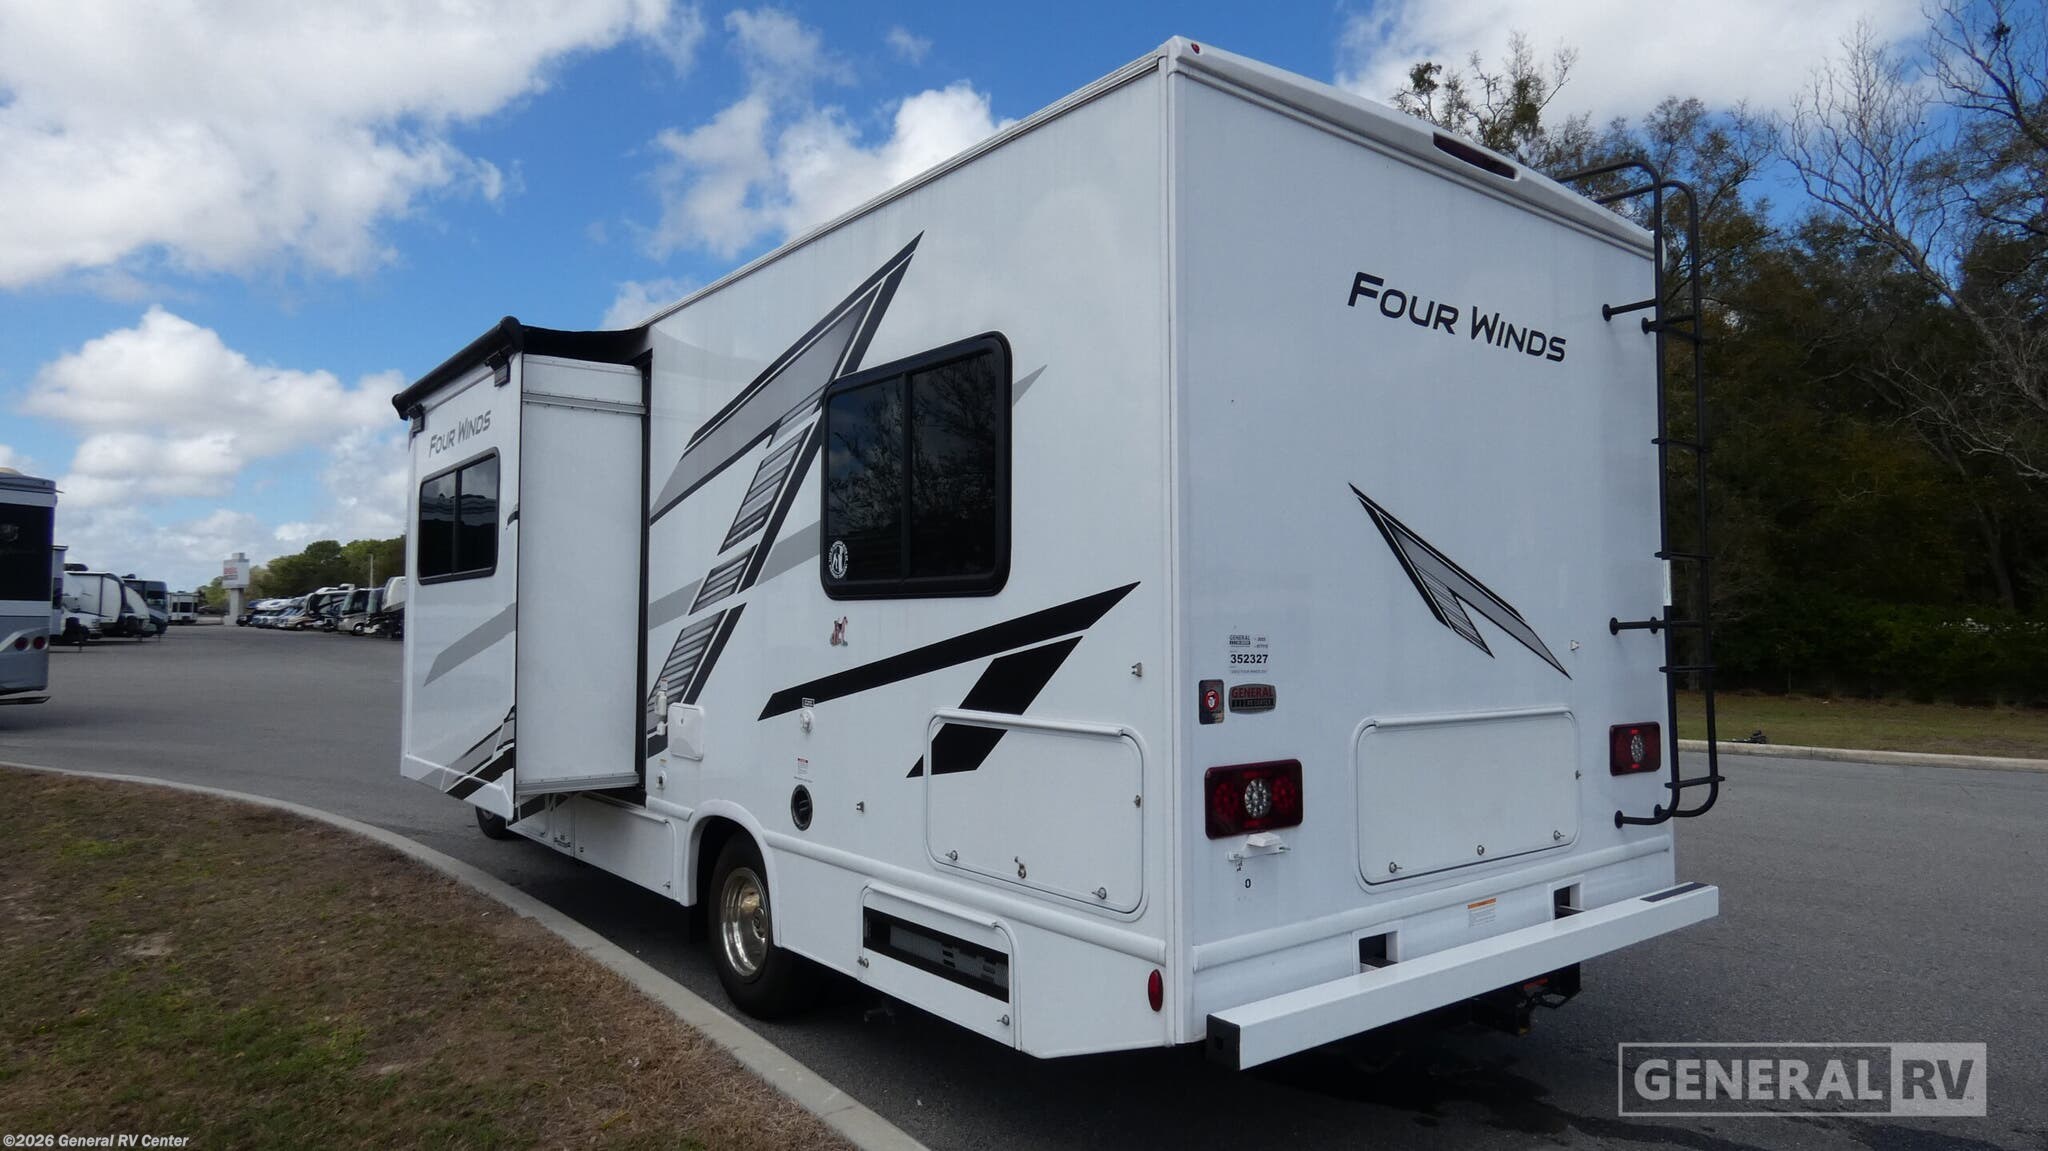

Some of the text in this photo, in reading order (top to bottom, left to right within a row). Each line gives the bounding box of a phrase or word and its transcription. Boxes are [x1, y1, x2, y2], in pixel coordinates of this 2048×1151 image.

[1347, 271, 1567, 363] FOUR WINDS
[428, 410, 491, 458] FOUR WINDS
[1230, 654, 1268, 664] 352327
[1231, 687, 1274, 698] GENERAL
